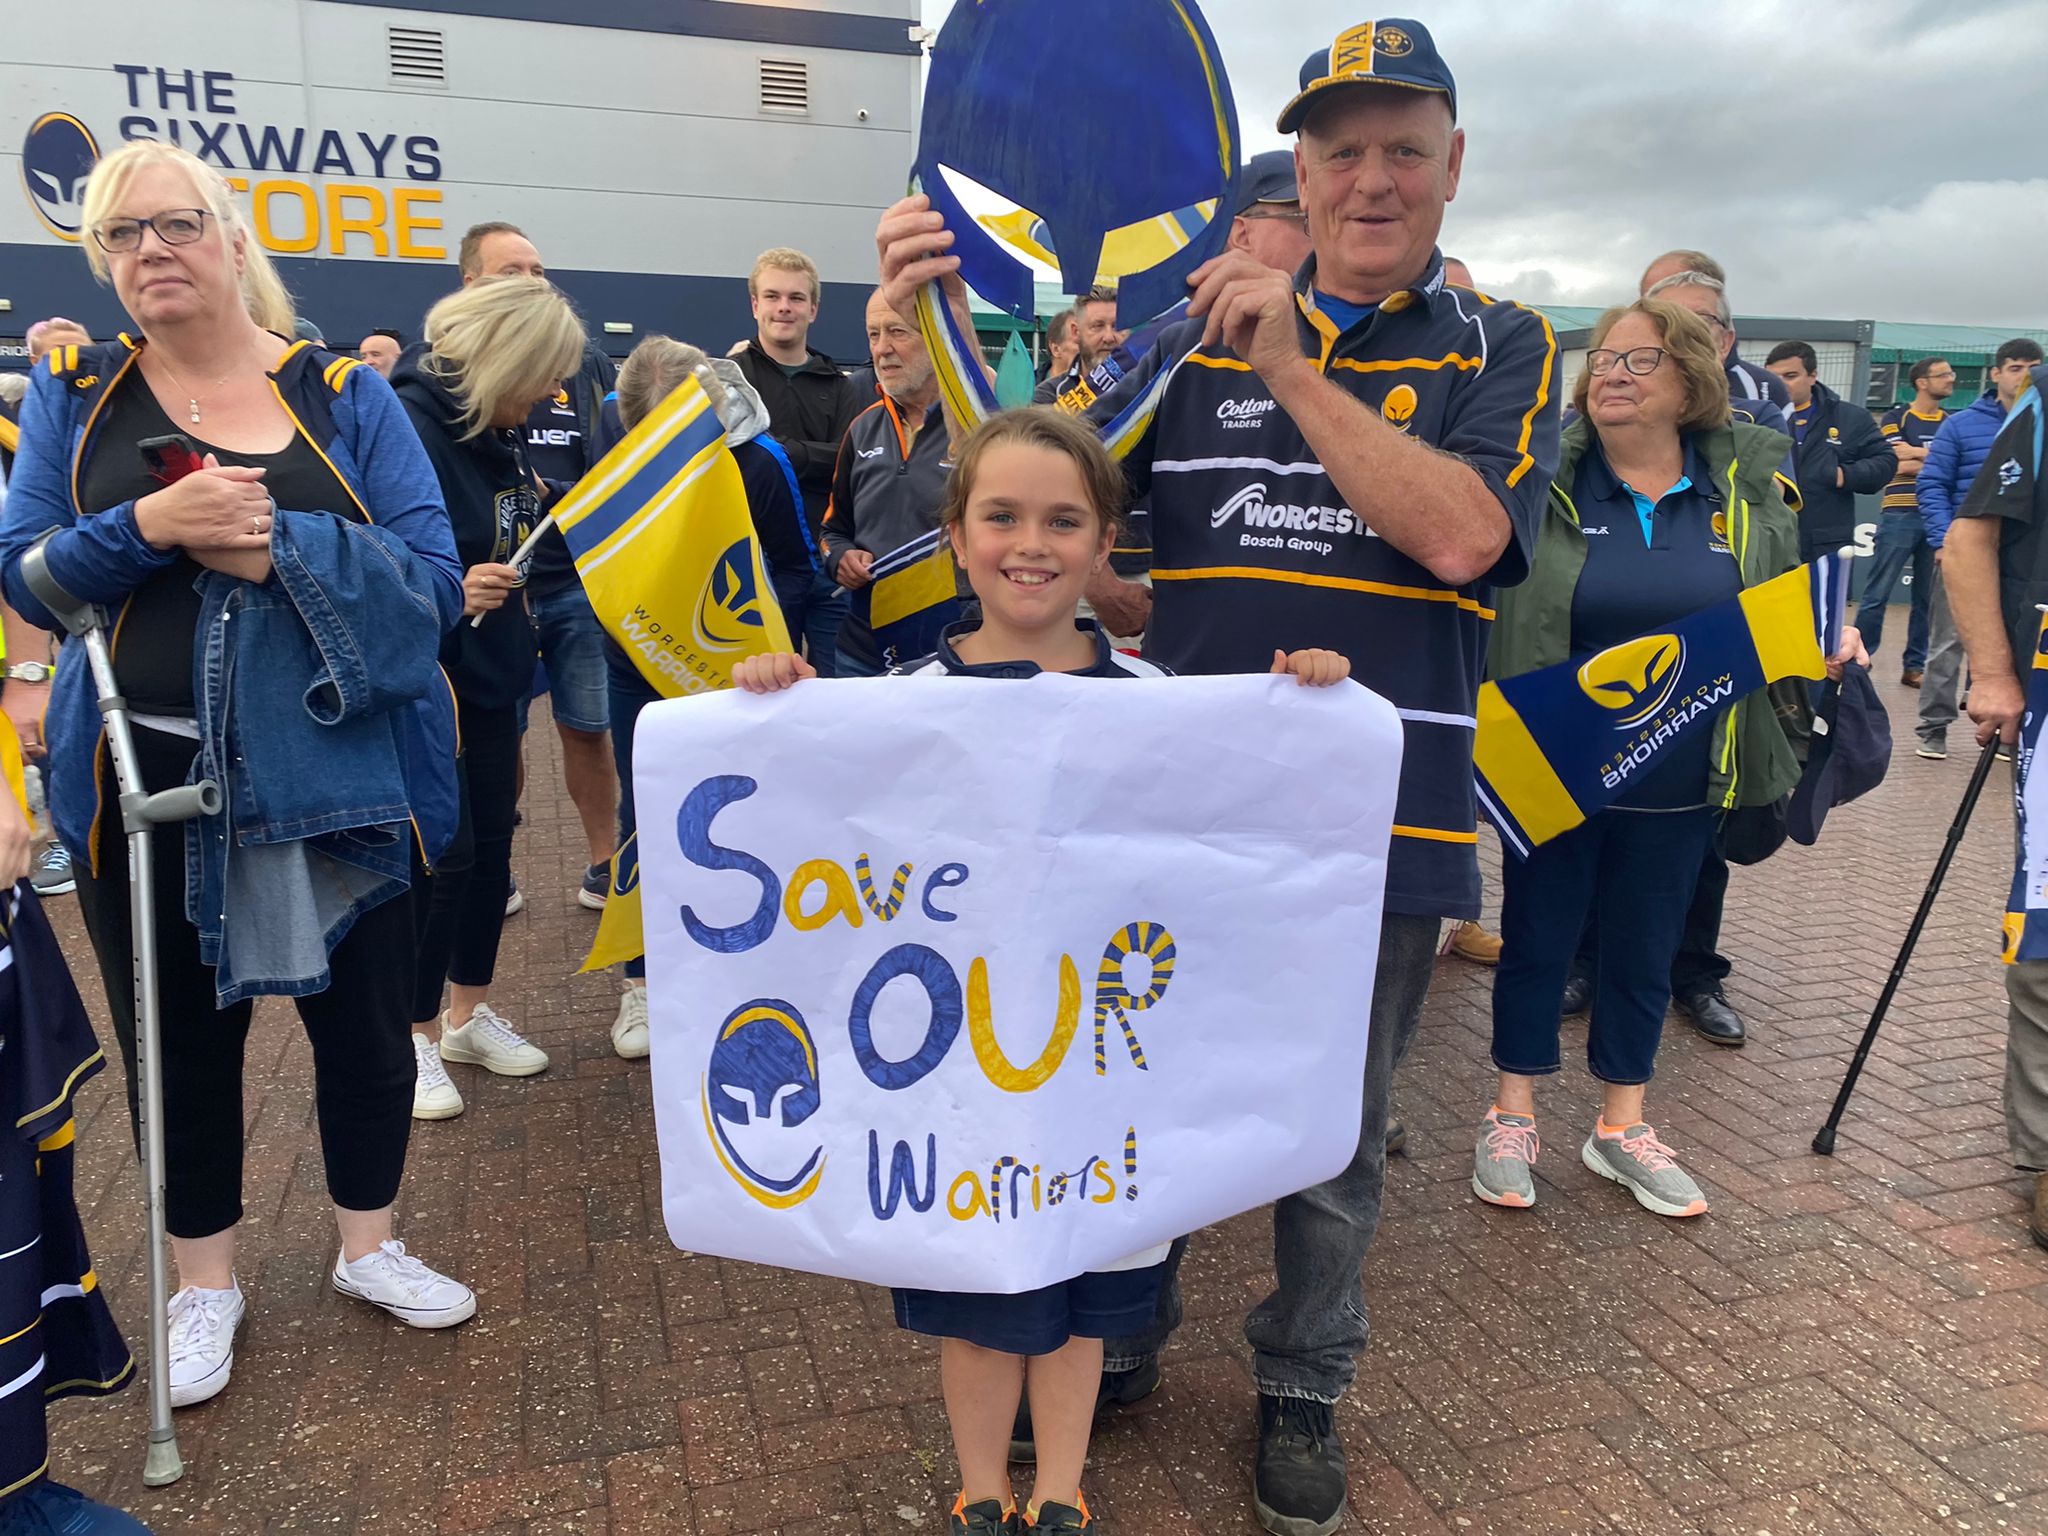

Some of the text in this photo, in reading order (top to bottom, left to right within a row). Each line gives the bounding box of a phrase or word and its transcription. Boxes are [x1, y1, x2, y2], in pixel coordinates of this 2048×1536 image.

[114, 63, 236, 115] THE
[1217, 398, 1276, 418] Cotton
[1222, 419, 1262, 429] TRADERS
[1240, 533, 1284, 549] Bosch
[1287, 537, 1333, 556] Group
[620, 613, 716, 694] WARRIO
[634, 604, 729, 689] WORCESTE
[677, 774, 969, 953] Save
[849, 920, 1176, 1093] OUR
[868, 1125, 1138, 1223] Warriors!
